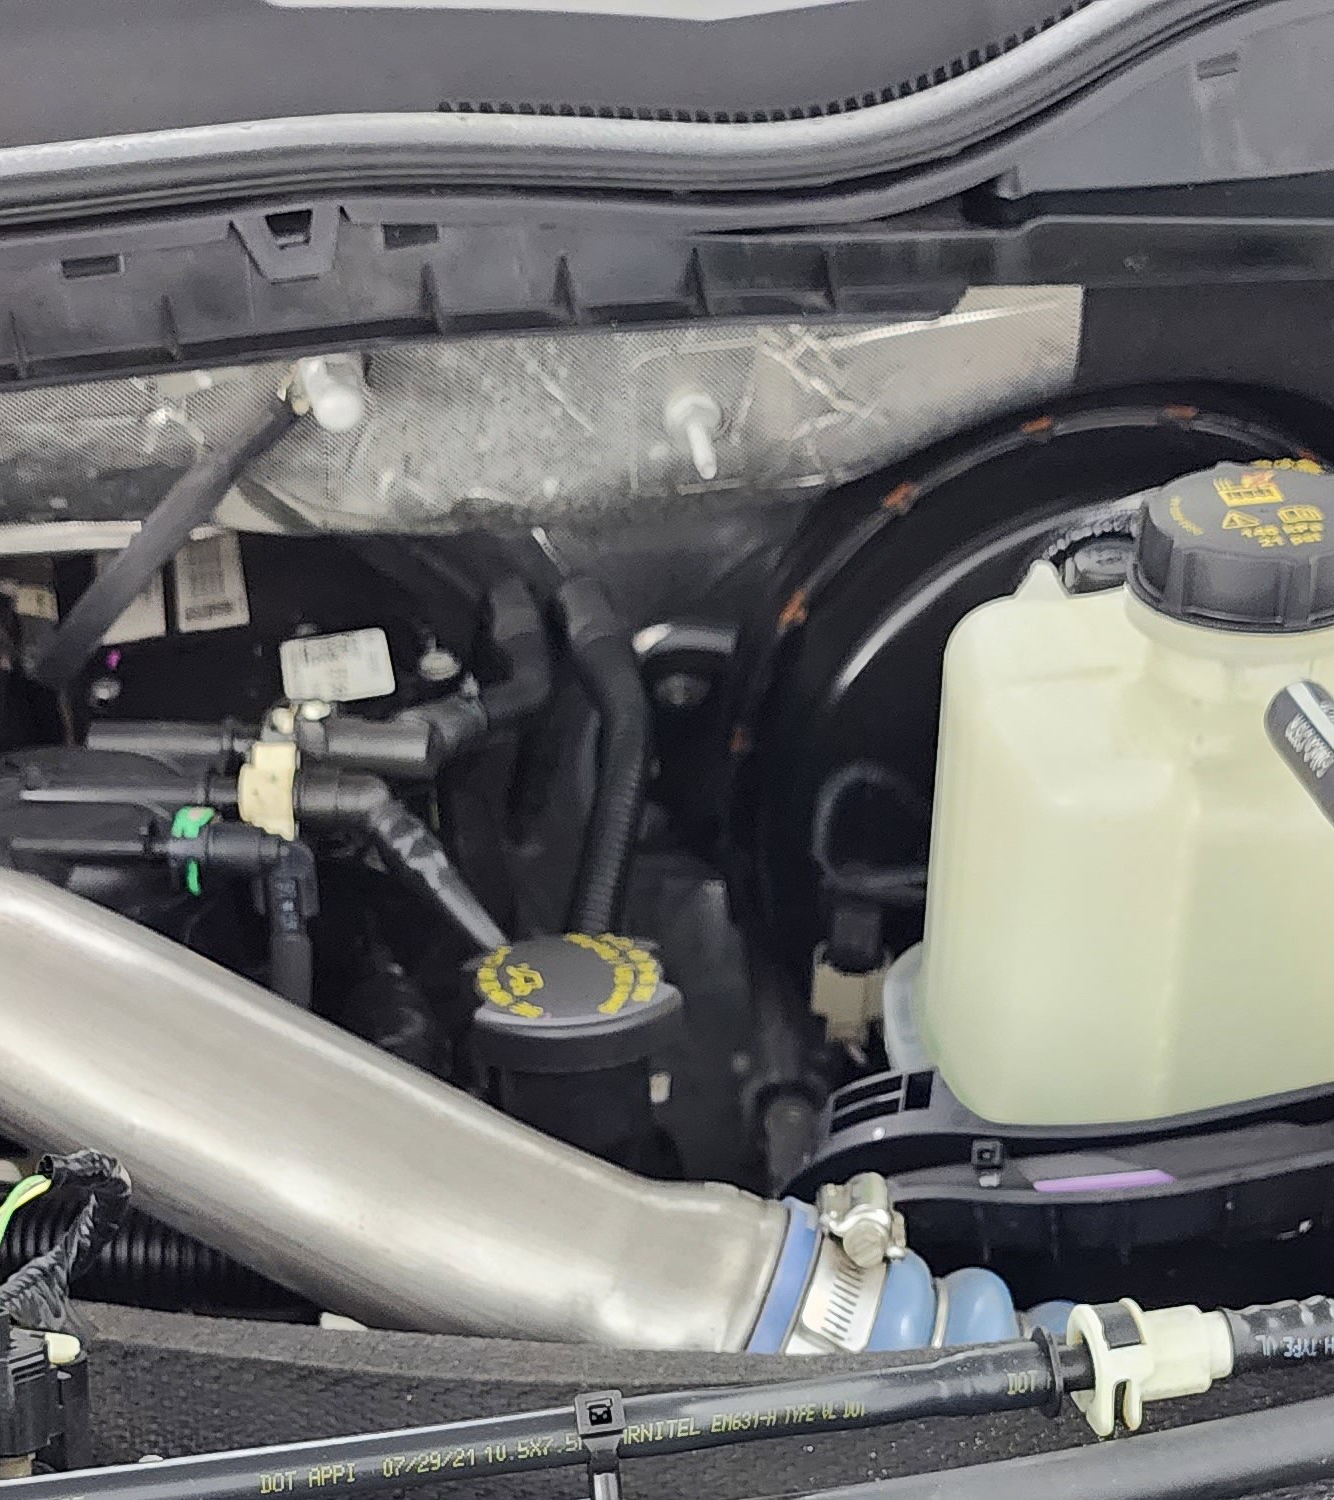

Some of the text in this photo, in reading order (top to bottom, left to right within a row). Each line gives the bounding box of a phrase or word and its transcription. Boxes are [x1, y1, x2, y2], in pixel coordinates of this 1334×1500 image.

[1283, 1335, 1317, 1358] TYPE
[1007, 1371, 1038, 1395] DOT
[260, 1470, 297, 1495] DOT
[308, 1462, 356, 1489] APPI
[382, 1447, 476, 1478] 07/29/21
